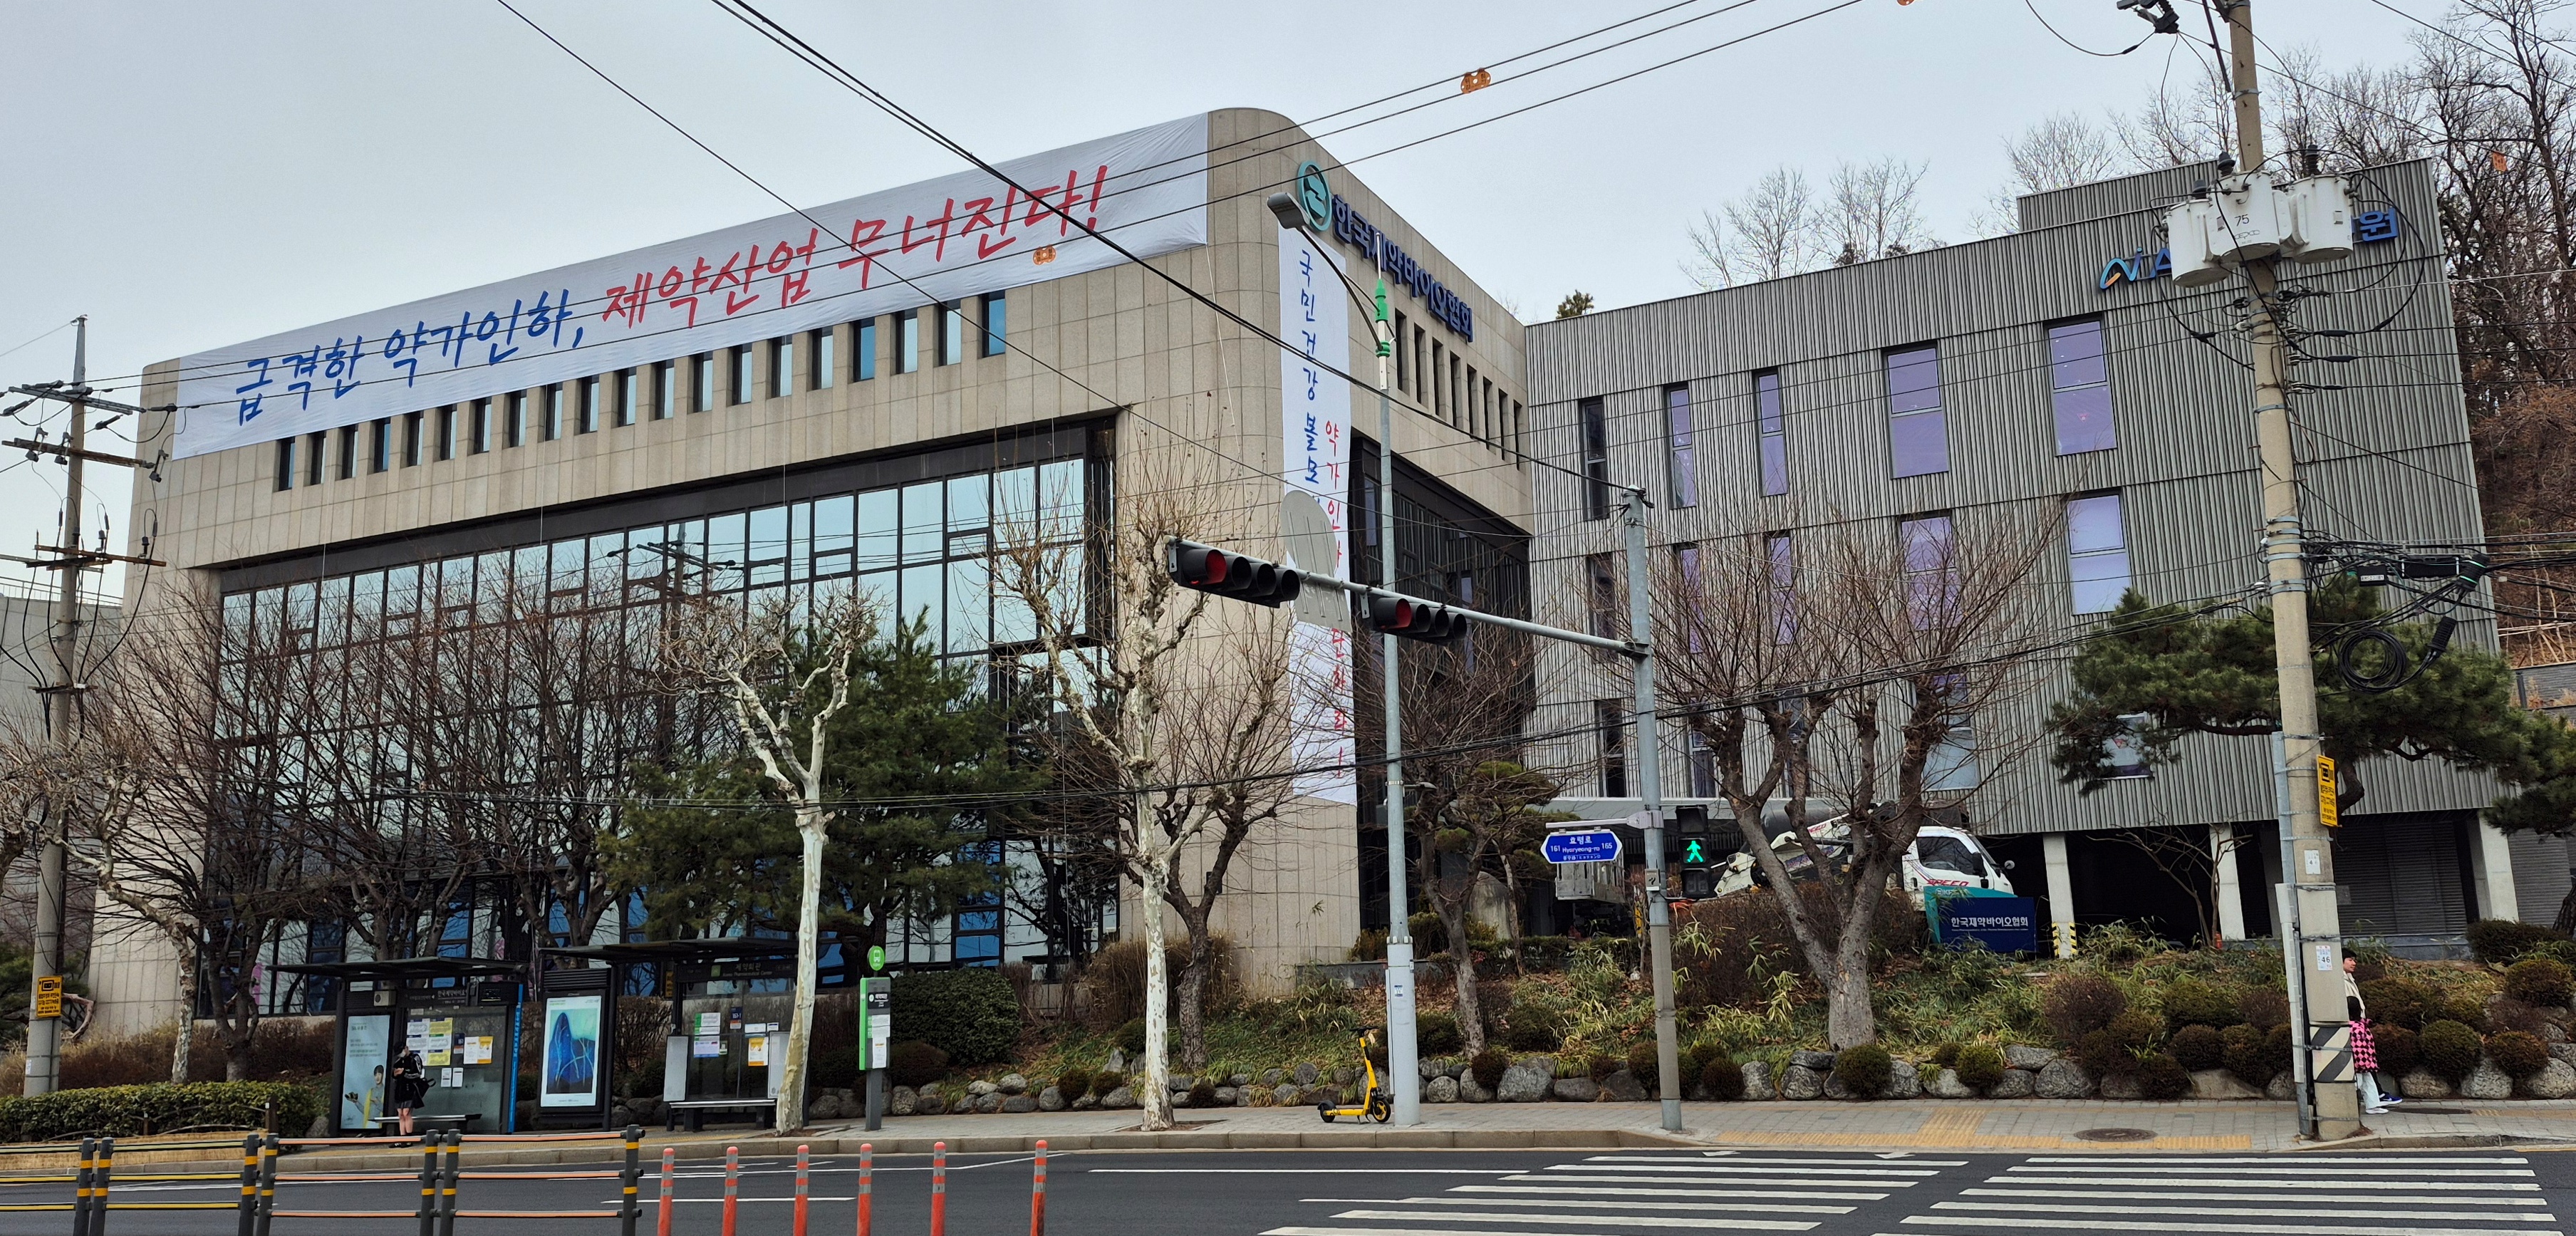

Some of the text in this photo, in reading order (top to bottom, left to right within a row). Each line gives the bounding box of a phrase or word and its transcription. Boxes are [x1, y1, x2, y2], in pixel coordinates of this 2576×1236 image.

[2234, 214, 2250, 227] 75
[1331, 194, 1473, 343] 한국제약바이오협회
[237, 165, 1108, 426] 급격한 약가인하, 제약산업 무너진다!
[1569, 836, 1592, 845] 효령로
[1951, 917, 2029, 928] 한국제약바이오협회
